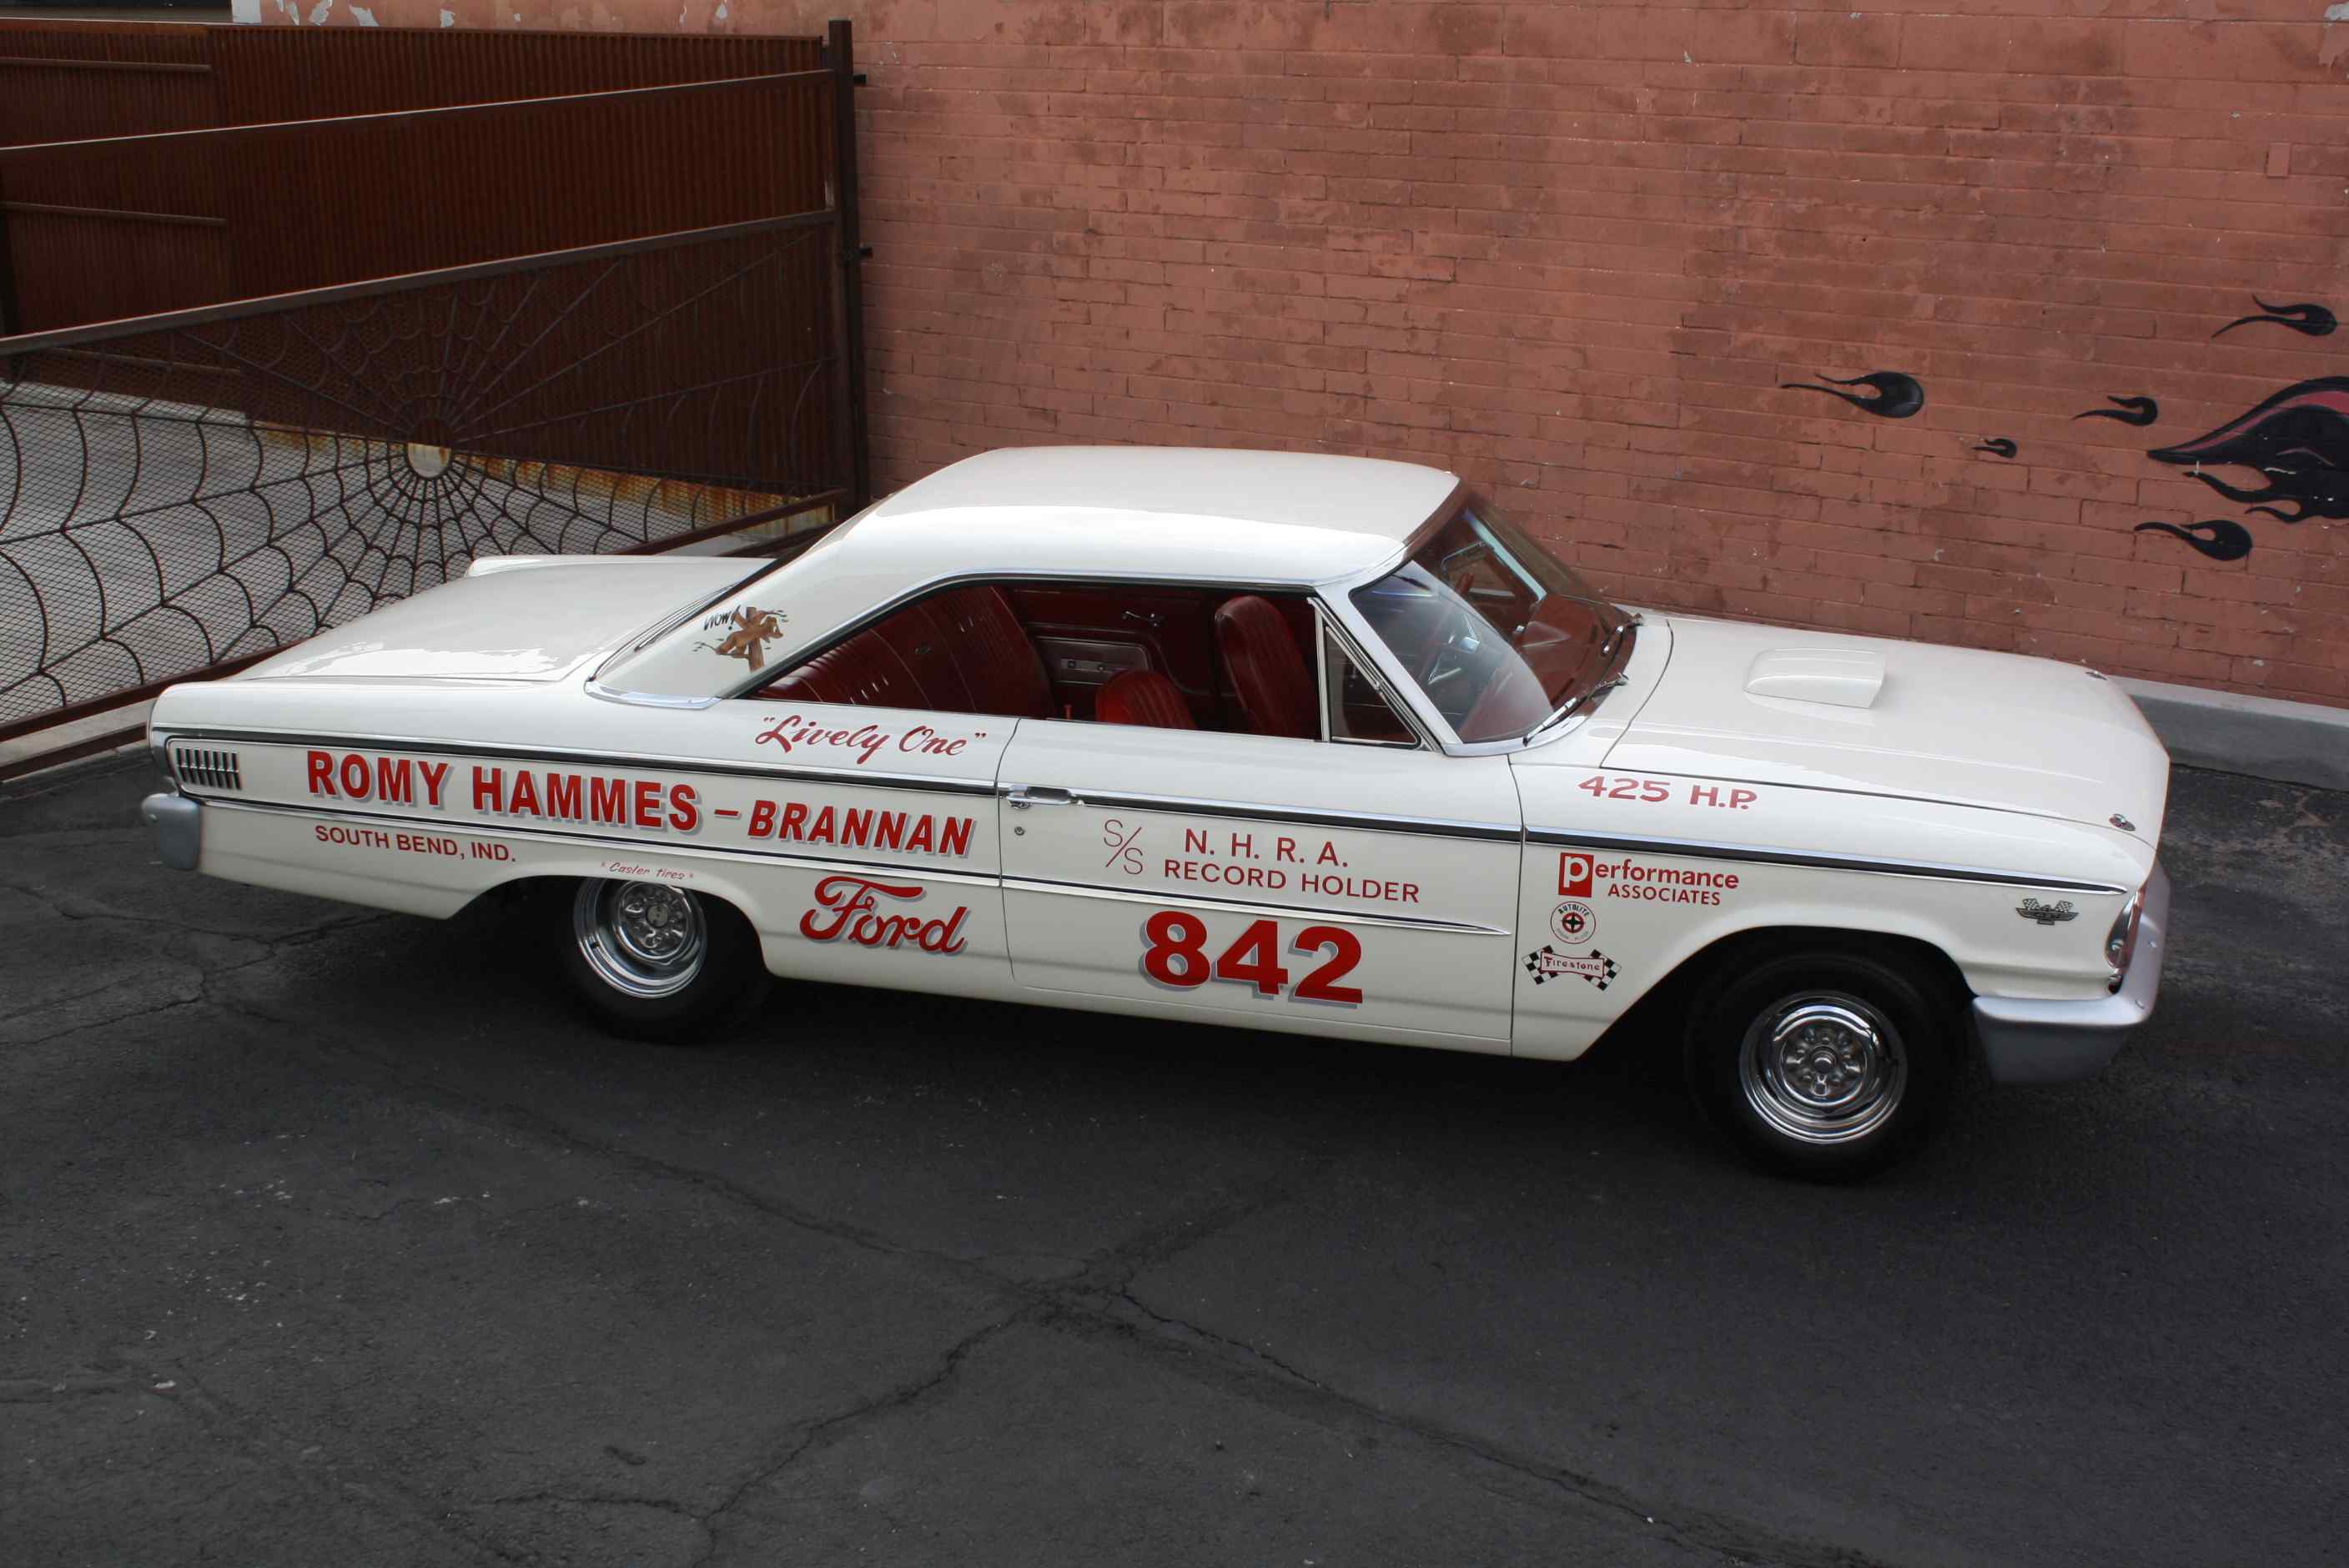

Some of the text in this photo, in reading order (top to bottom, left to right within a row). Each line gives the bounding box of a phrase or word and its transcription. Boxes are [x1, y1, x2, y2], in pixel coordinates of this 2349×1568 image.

[306, 750, 450, 809] ROMY
[471, 765, 703, 835] HAMMES
[747, 798, 977, 859] BRANNAN
[1577, 775, 1671, 802] 425
[314, 825, 517, 862] SOUTH BEND, IND.
[1164, 859, 1421, 905] RECORD HOLDER
[1607, 883, 1722, 907] ASSOCIATES
[798, 876, 969, 957] Ford
[1140, 910, 1365, 1006] 842
[1543, 955, 1601, 971] Firestone
